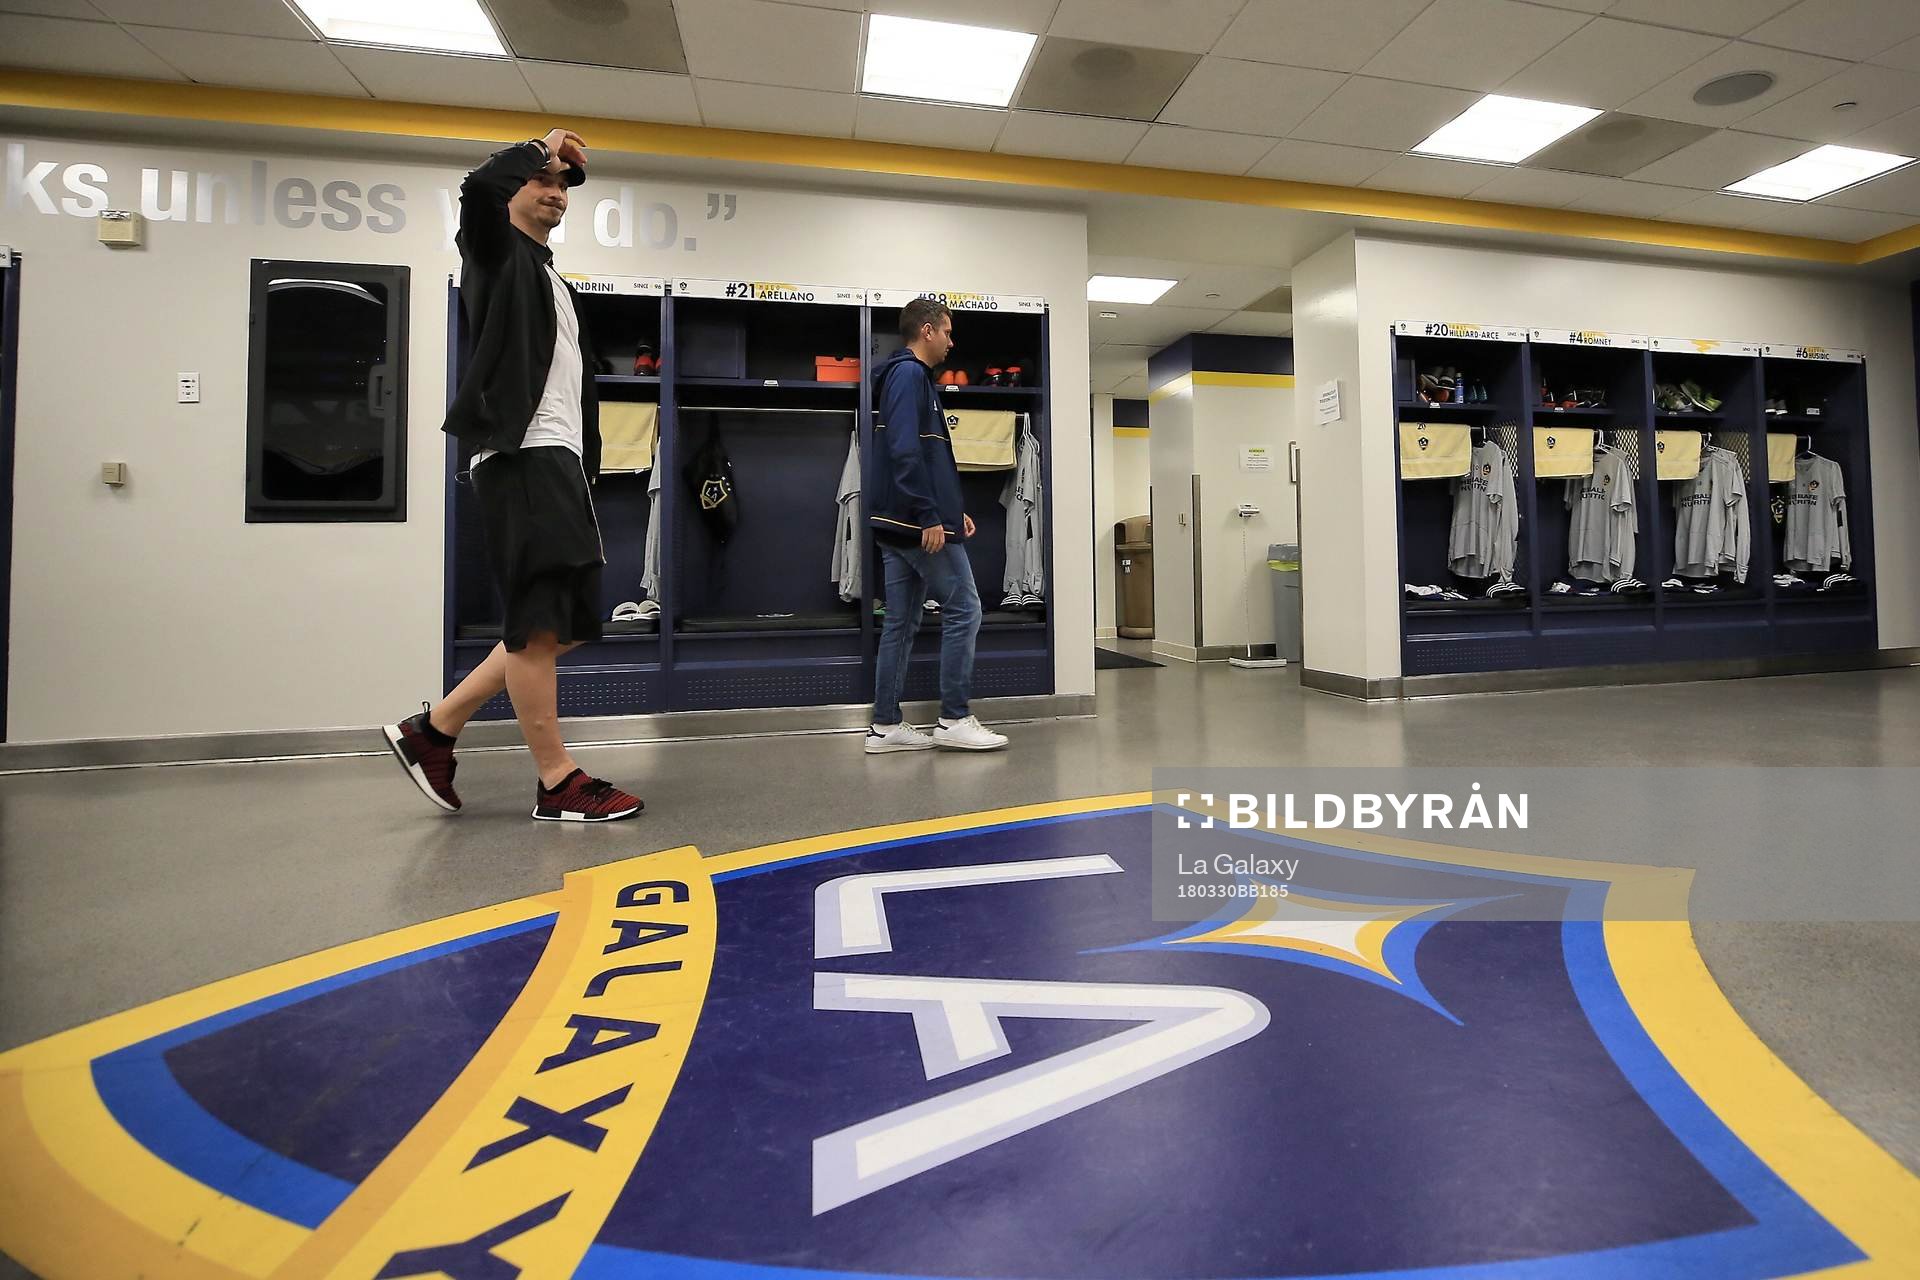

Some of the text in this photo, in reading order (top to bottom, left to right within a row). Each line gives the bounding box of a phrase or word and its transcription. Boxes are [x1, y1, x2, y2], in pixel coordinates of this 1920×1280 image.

[141, 160, 407, 234] unless
[724, 282, 756, 299] #21
[759, 290, 815, 302] ARELLANO
[949, 300, 998, 310] MACHADO
[1425, 323, 1449, 336] #20
[1449, 329, 1500, 339] HILLIARD-ARCE
[1569, 331, 1583, 343] #4
[1583, 338, 1612, 346] ROMNEY
[1796, 348, 1808, 359] #6
[812, 854, 1271, 1216] LA
[373, 880, 692, 1280] GALAXY
